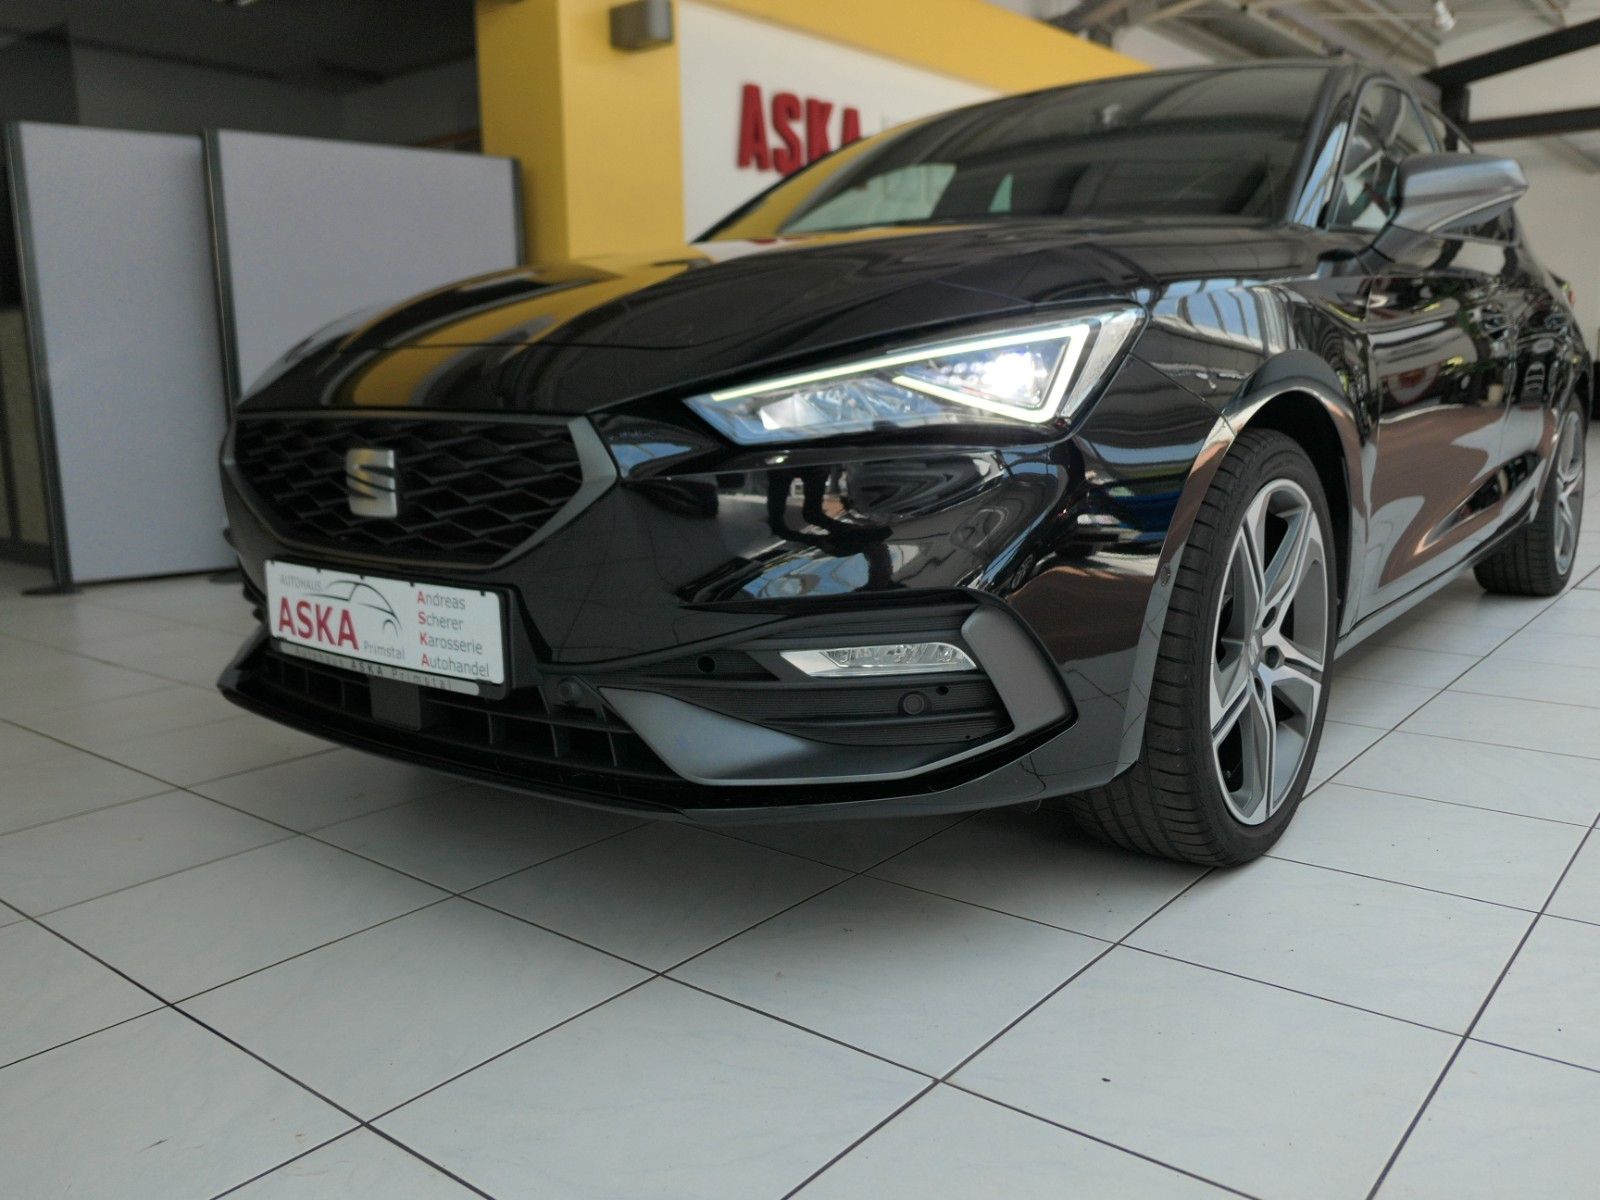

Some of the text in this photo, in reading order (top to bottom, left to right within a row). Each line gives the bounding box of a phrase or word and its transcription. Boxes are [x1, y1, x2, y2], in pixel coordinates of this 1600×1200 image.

[417, 590, 467, 611] Andreas
[278, 596, 360, 651] ASKA
[417, 611, 464, 631] Scherer
[363, 640, 405, 660] Primstal
[419, 631, 483, 656] Karosserie
[351, 658, 384, 677] ASKA
[421, 652, 490, 678] Autohandel
